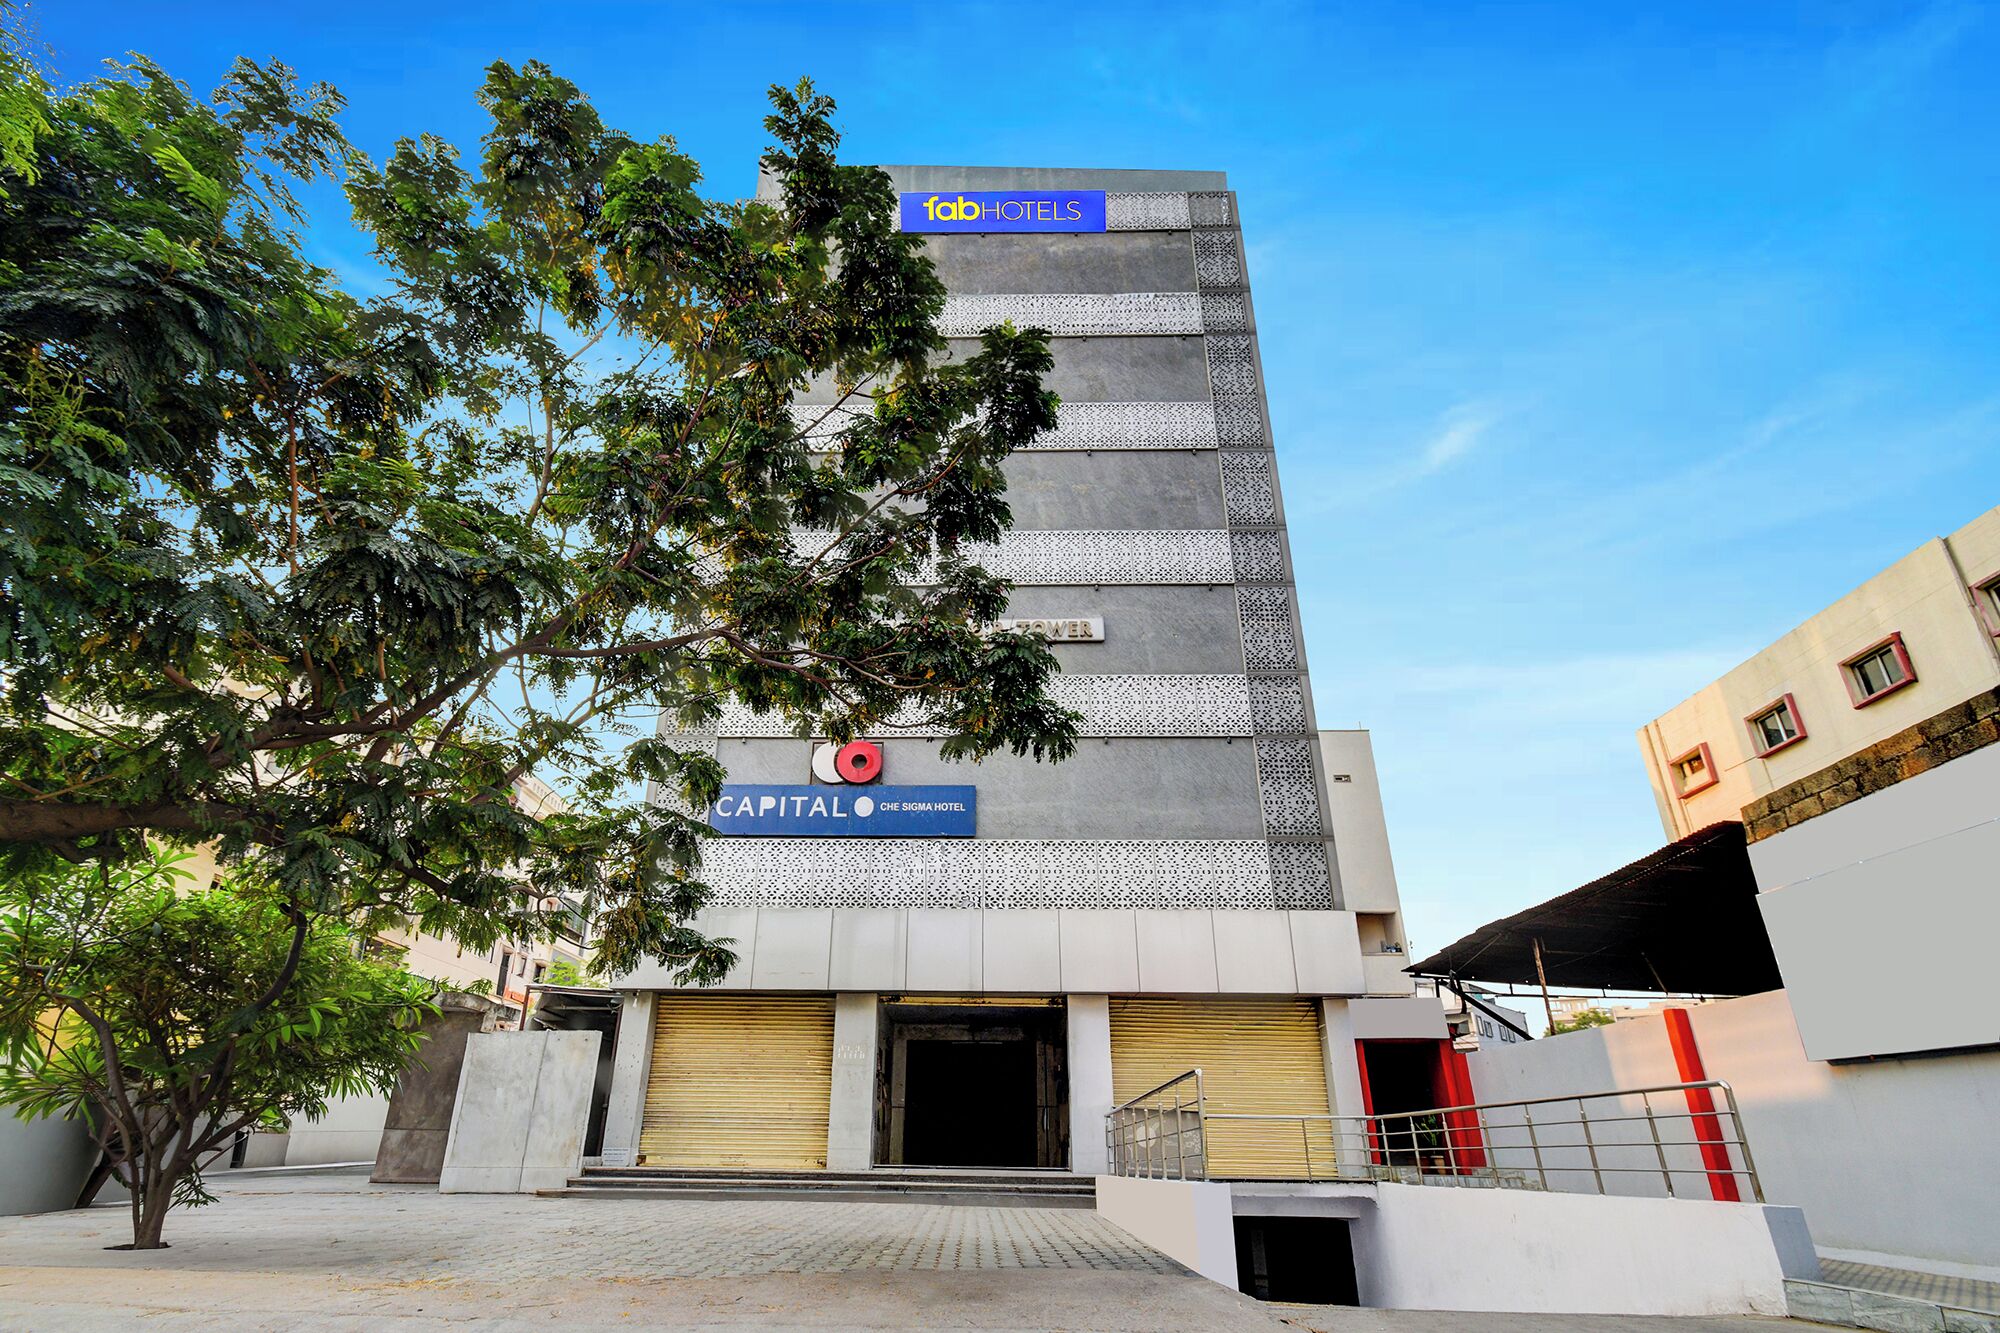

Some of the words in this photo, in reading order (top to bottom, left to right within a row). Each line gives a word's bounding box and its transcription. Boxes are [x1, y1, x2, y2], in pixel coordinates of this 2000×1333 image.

[1016, 620, 1094, 638] TOWER
[715, 795, 848, 817] CAPITAL
[880, 802, 900, 811] CHE
[902, 802, 933, 811] SIGMA
[934, 802, 966, 812] HOTEL
